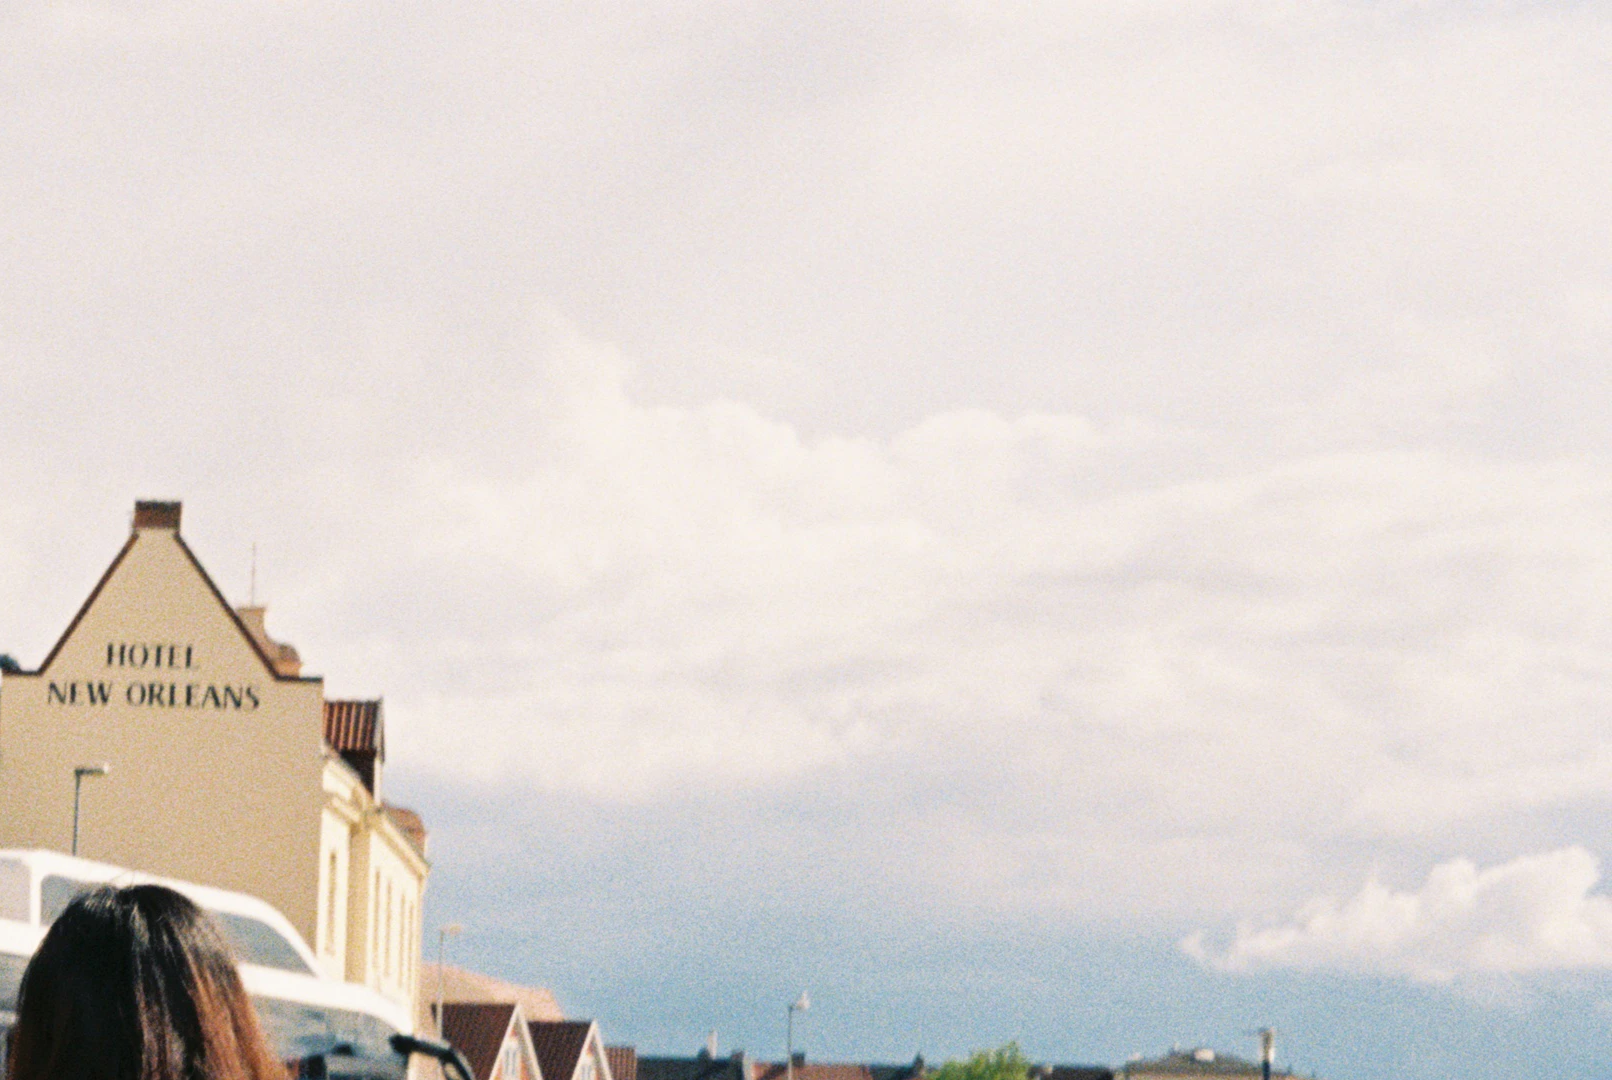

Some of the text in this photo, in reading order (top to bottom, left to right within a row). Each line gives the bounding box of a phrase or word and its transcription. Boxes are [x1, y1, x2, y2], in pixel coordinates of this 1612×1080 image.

[106, 643, 200, 669] HOTEL
[47, 681, 261, 710] NEW ORLEANS
